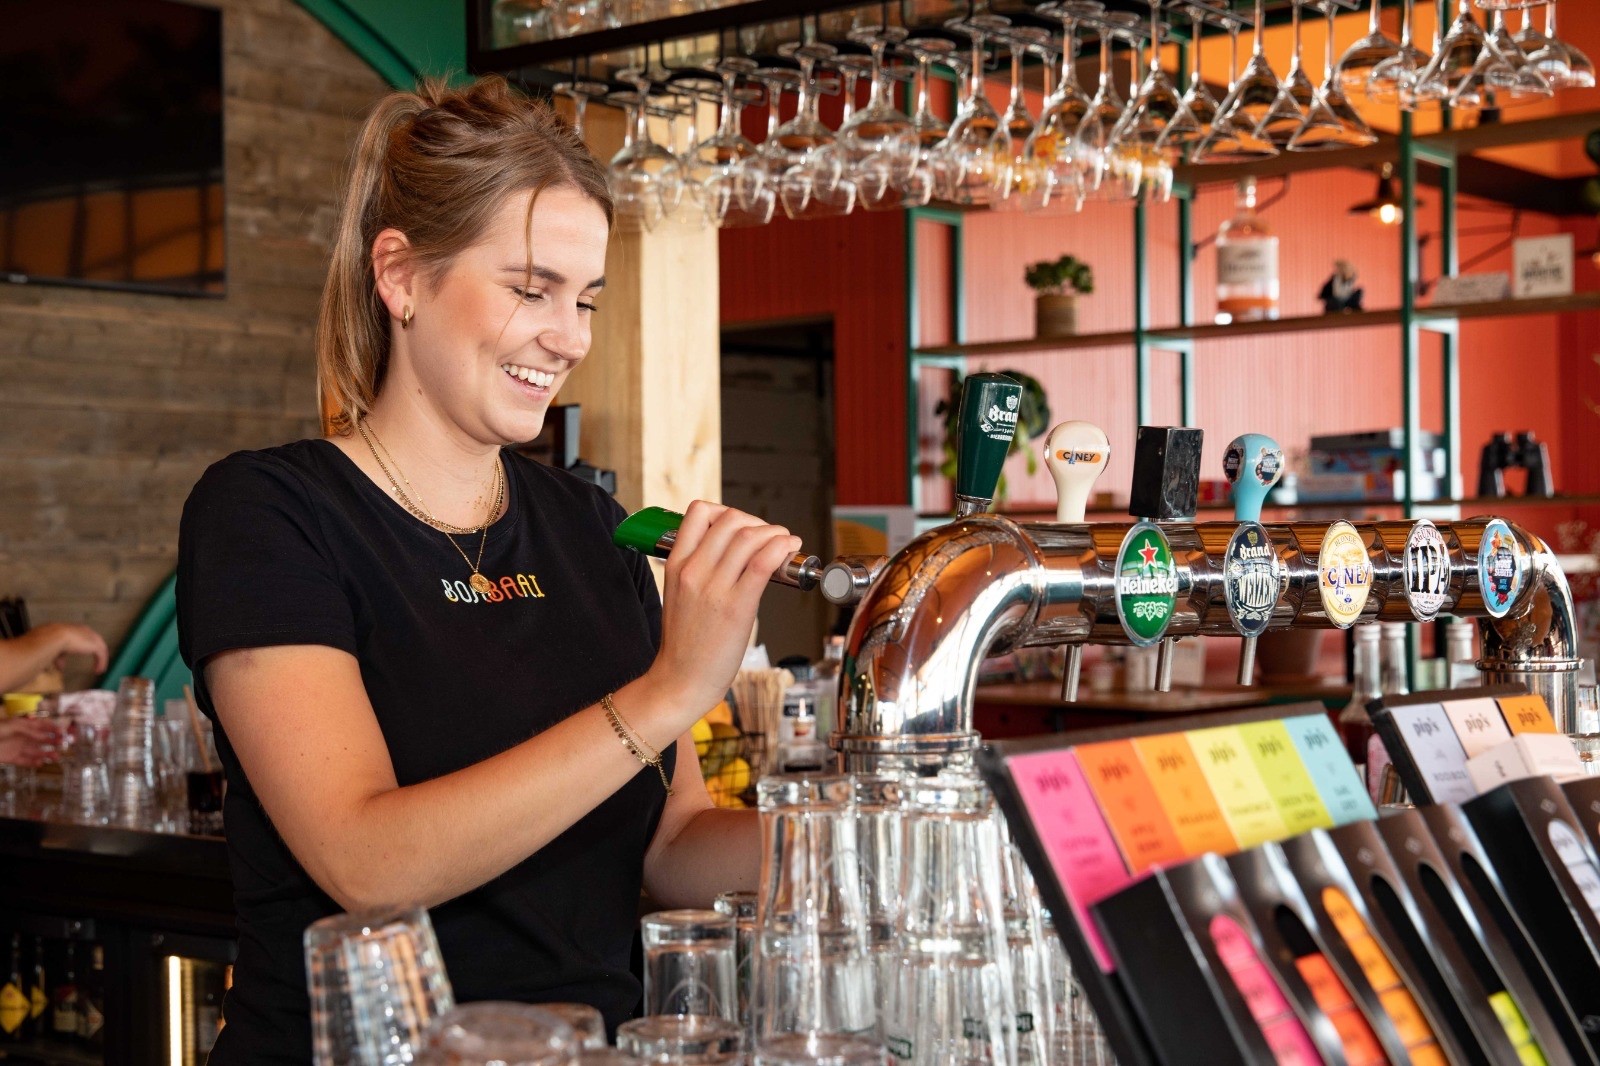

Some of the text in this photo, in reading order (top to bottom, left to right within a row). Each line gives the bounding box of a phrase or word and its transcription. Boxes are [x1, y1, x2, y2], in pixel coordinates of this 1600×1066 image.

[988, 405, 1019, 423] Bran
[1240, 543, 1271, 560] Brand
[1410, 545, 1449, 594] IPA
[1464, 713, 1491, 733] pip's
[1517, 708, 1543, 725] pip's
[1412, 717, 1440, 736] pip's
